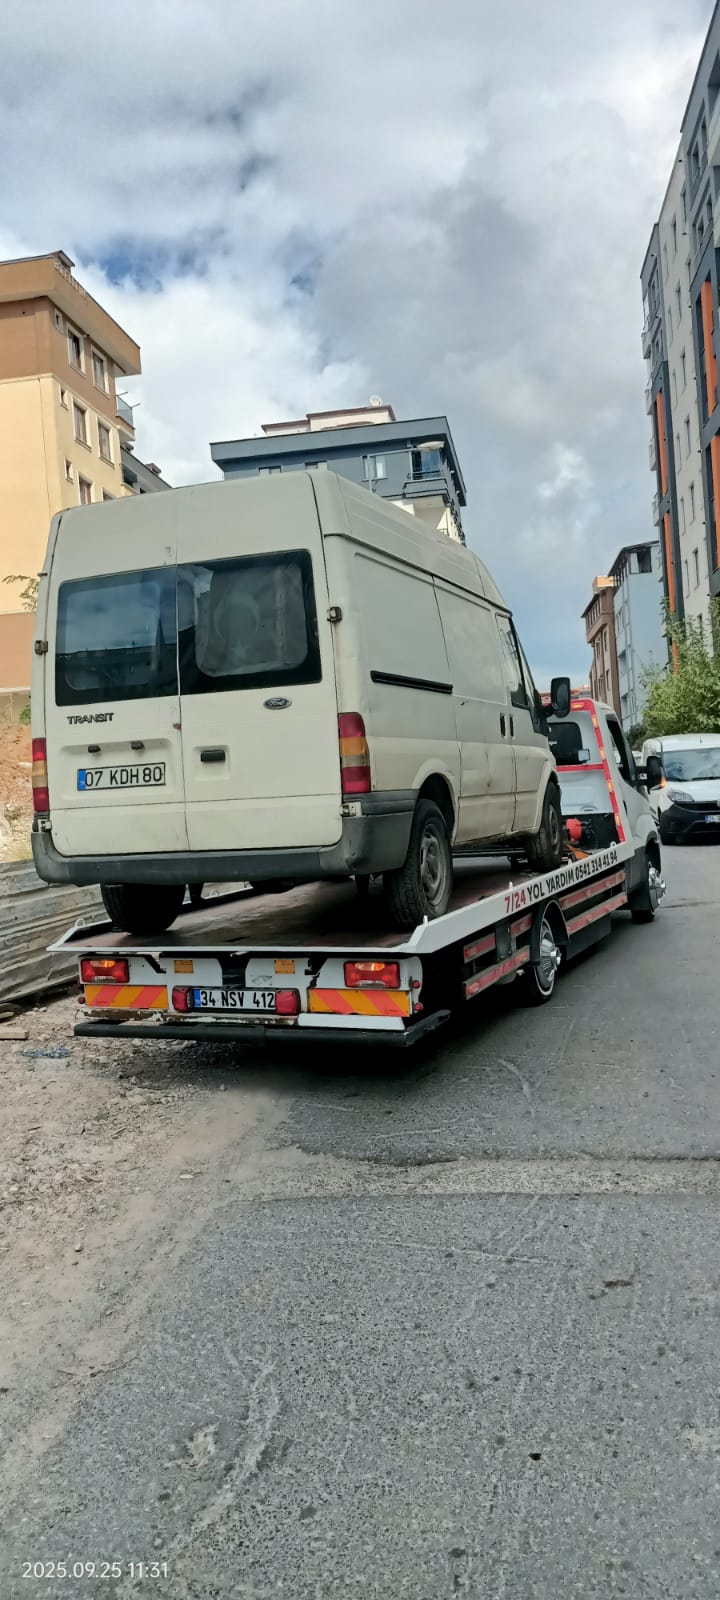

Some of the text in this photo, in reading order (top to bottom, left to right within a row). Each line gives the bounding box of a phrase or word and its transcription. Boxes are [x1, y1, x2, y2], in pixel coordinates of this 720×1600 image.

[67, 713, 114, 724] TRANSIT
[85, 766, 162, 786] 07 KDH 80
[505, 889, 526, 913] 7/24
[527, 882, 545, 901] YOL
[546, 868, 575, 893] YARDIM
[575, 863, 591, 880] 0541
[603, 852, 610, 867] 41
[610, 849, 618, 865] 94
[200, 991, 275, 1008] 34 NSV 412
